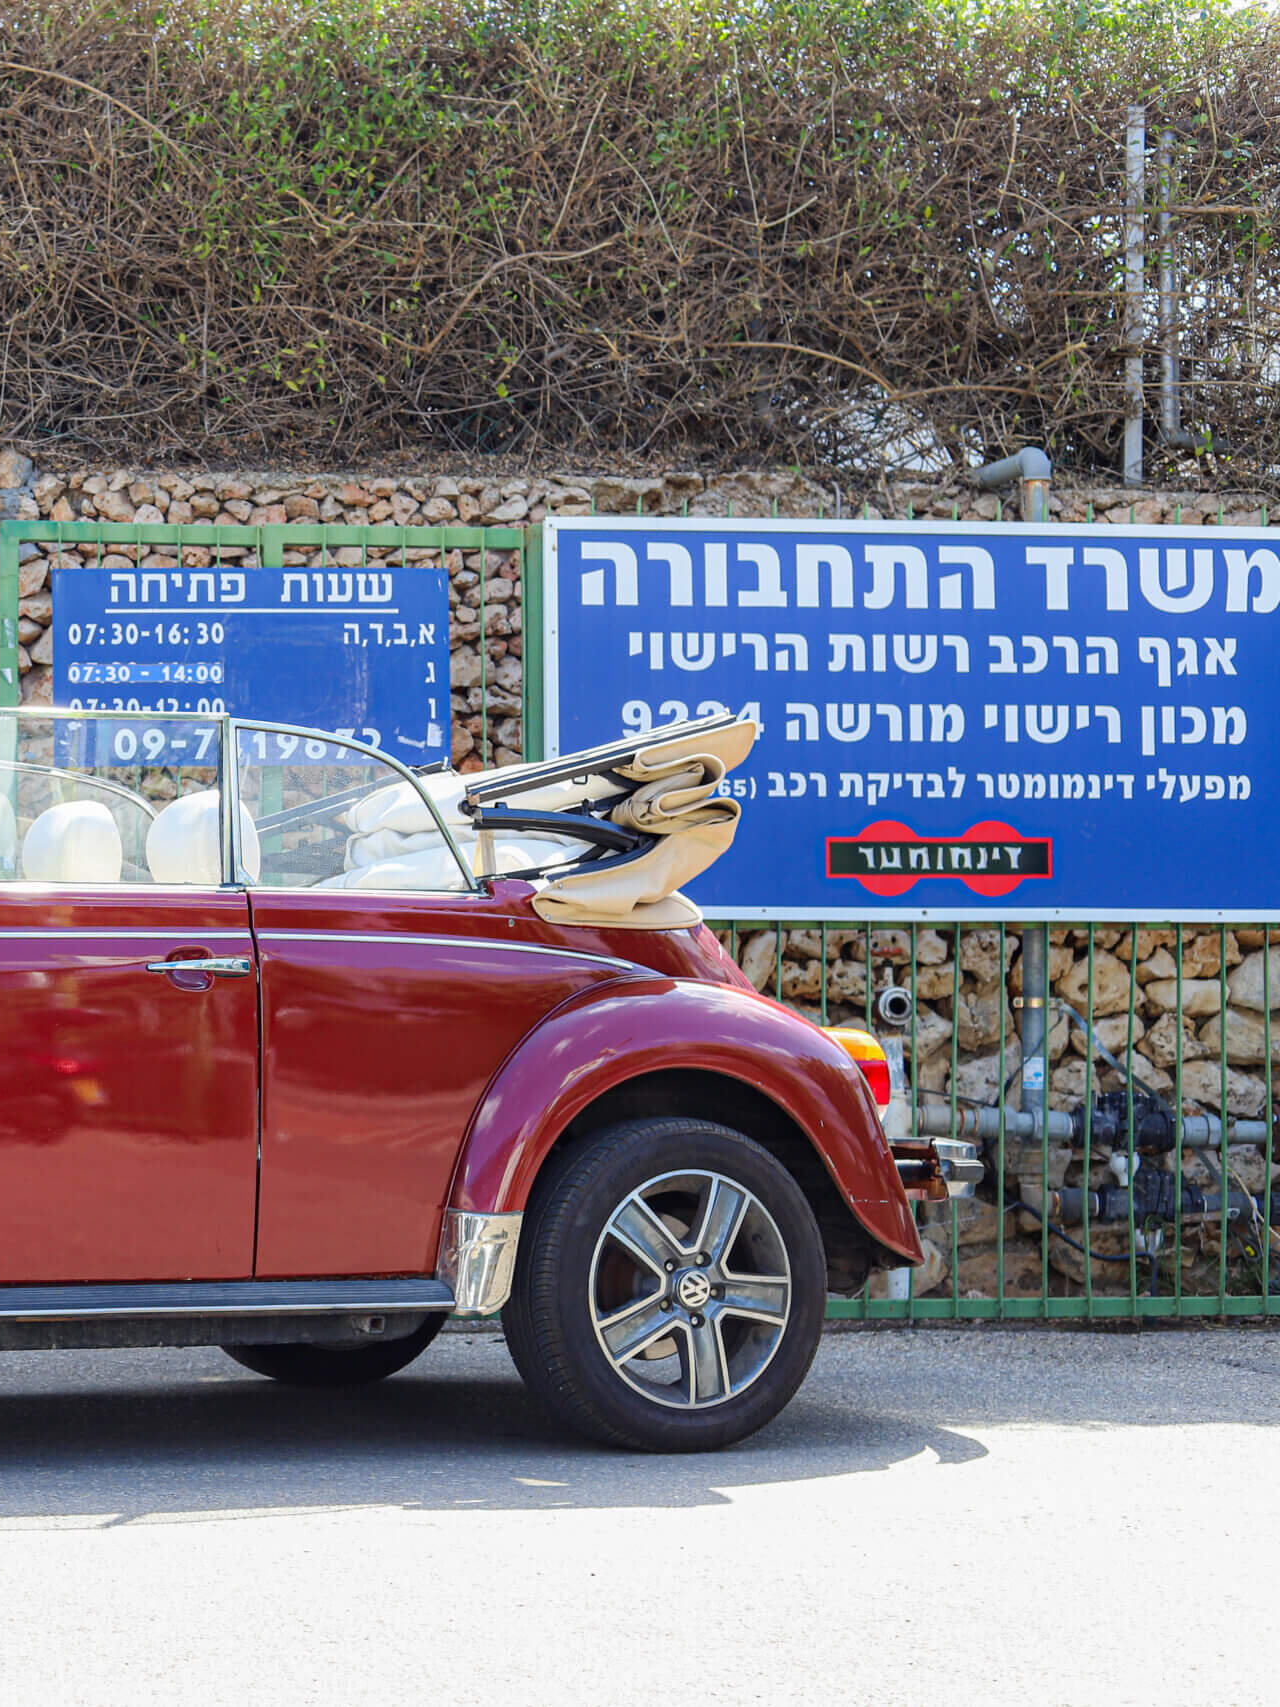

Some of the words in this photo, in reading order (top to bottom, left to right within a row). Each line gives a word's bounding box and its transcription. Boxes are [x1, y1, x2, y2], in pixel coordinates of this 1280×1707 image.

[110, 573, 247, 603] פתיחה
[280, 573, 393, 603] שעות
[580, 541, 996, 610] התחבורה
[1025, 546, 1280, 614] משרד
[68, 623, 225, 645] 07:30-16:30
[628, 632, 809, 671] הרישוי
[828, 634, 970, 673] רשות
[425, 662, 436, 683] ג
[988, 635, 1120, 674] הרכב
[1138, 637, 1238, 687] אגף
[786, 703, 965, 743] מורשה
[984, 705, 1121, 744] רישוי
[1141, 706, 1247, 756] מכון
[767, 772, 827, 798] רכב
[839, 766, 966, 806] לבדיקת
[976, 773, 1135, 799] דינמומטר
[1146, 767, 1251, 803] מפעלי
